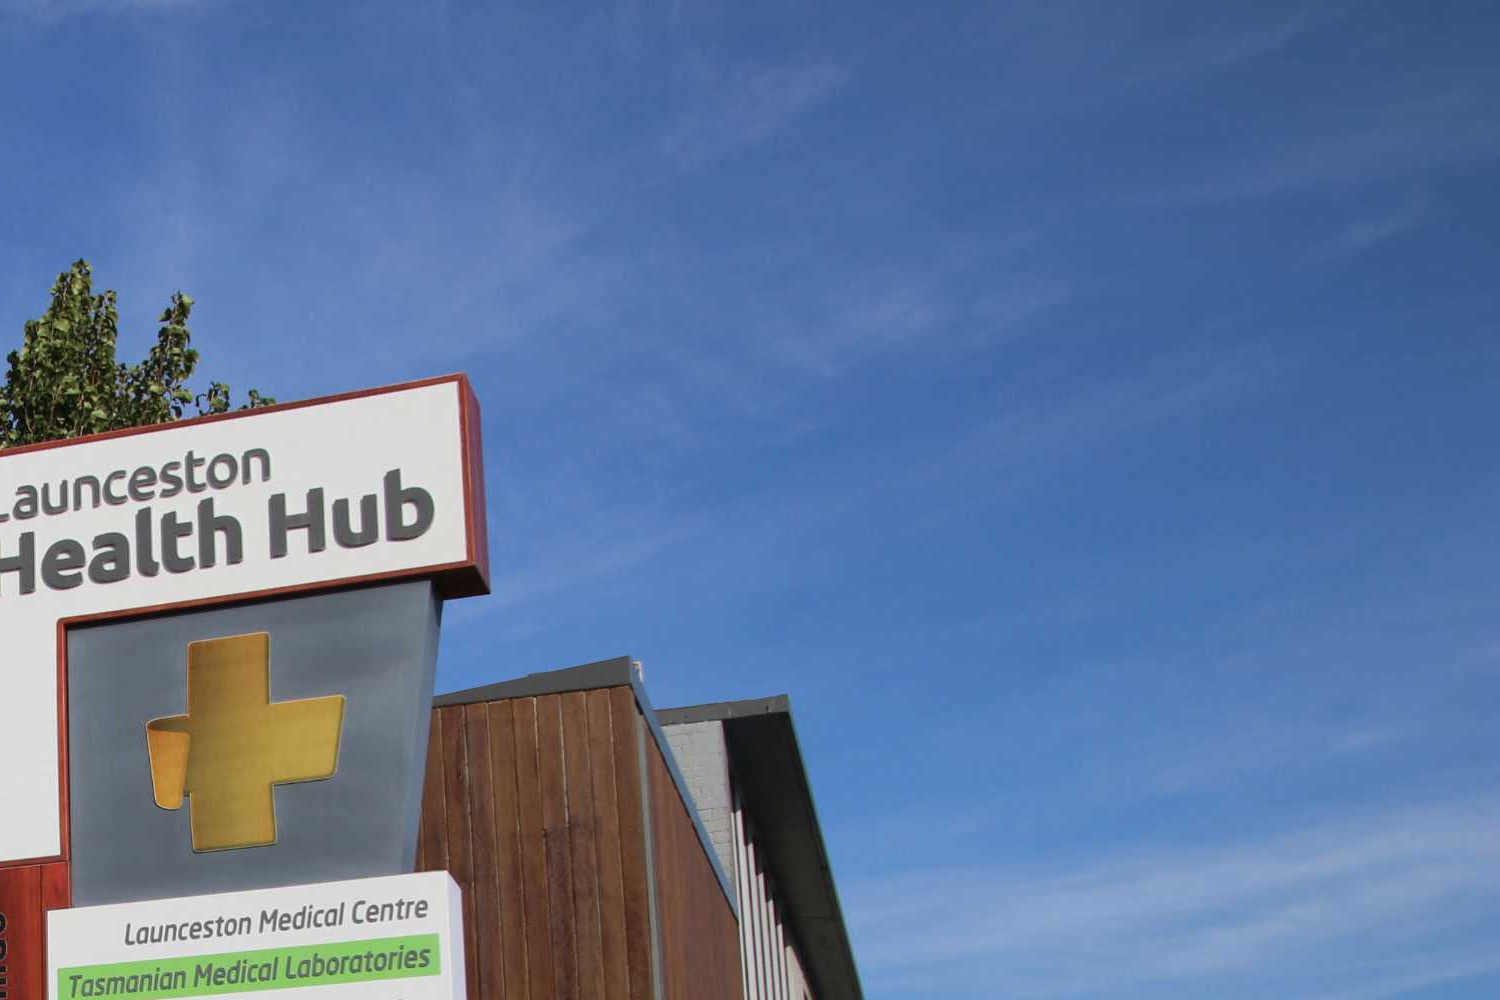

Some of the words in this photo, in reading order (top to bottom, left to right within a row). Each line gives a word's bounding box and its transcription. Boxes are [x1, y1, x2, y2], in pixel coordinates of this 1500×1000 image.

[268, 468, 435, 559] Hub
[125, 913, 251, 946] Launceston
[259, 903, 344, 935] Medical
[352, 898, 429, 924] Centre
[69, 967, 186, 998] Tasmanian
[193, 956, 278, 987] Medical
[285, 946, 431, 980] Laboratories
